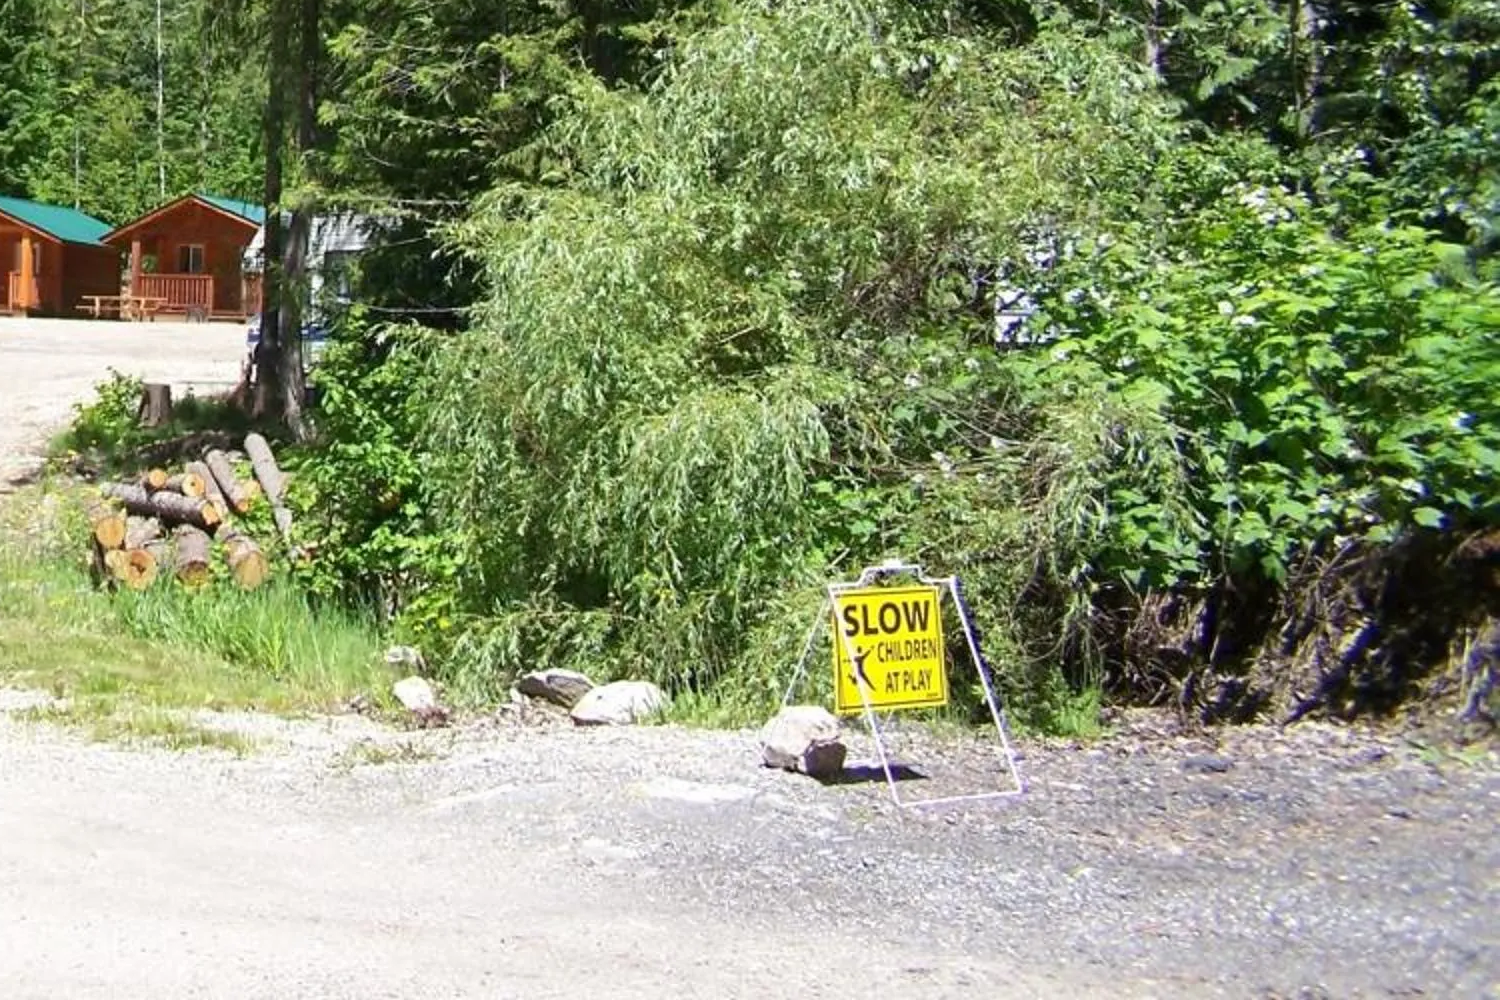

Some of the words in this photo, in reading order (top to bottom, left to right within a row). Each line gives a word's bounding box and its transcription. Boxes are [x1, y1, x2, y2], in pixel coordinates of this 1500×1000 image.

[843, 600, 929, 637] SLOW
[878, 638, 937, 662] CHILDREN
[886, 671, 900, 693] AT
[903, 669, 932, 692] PLAY
